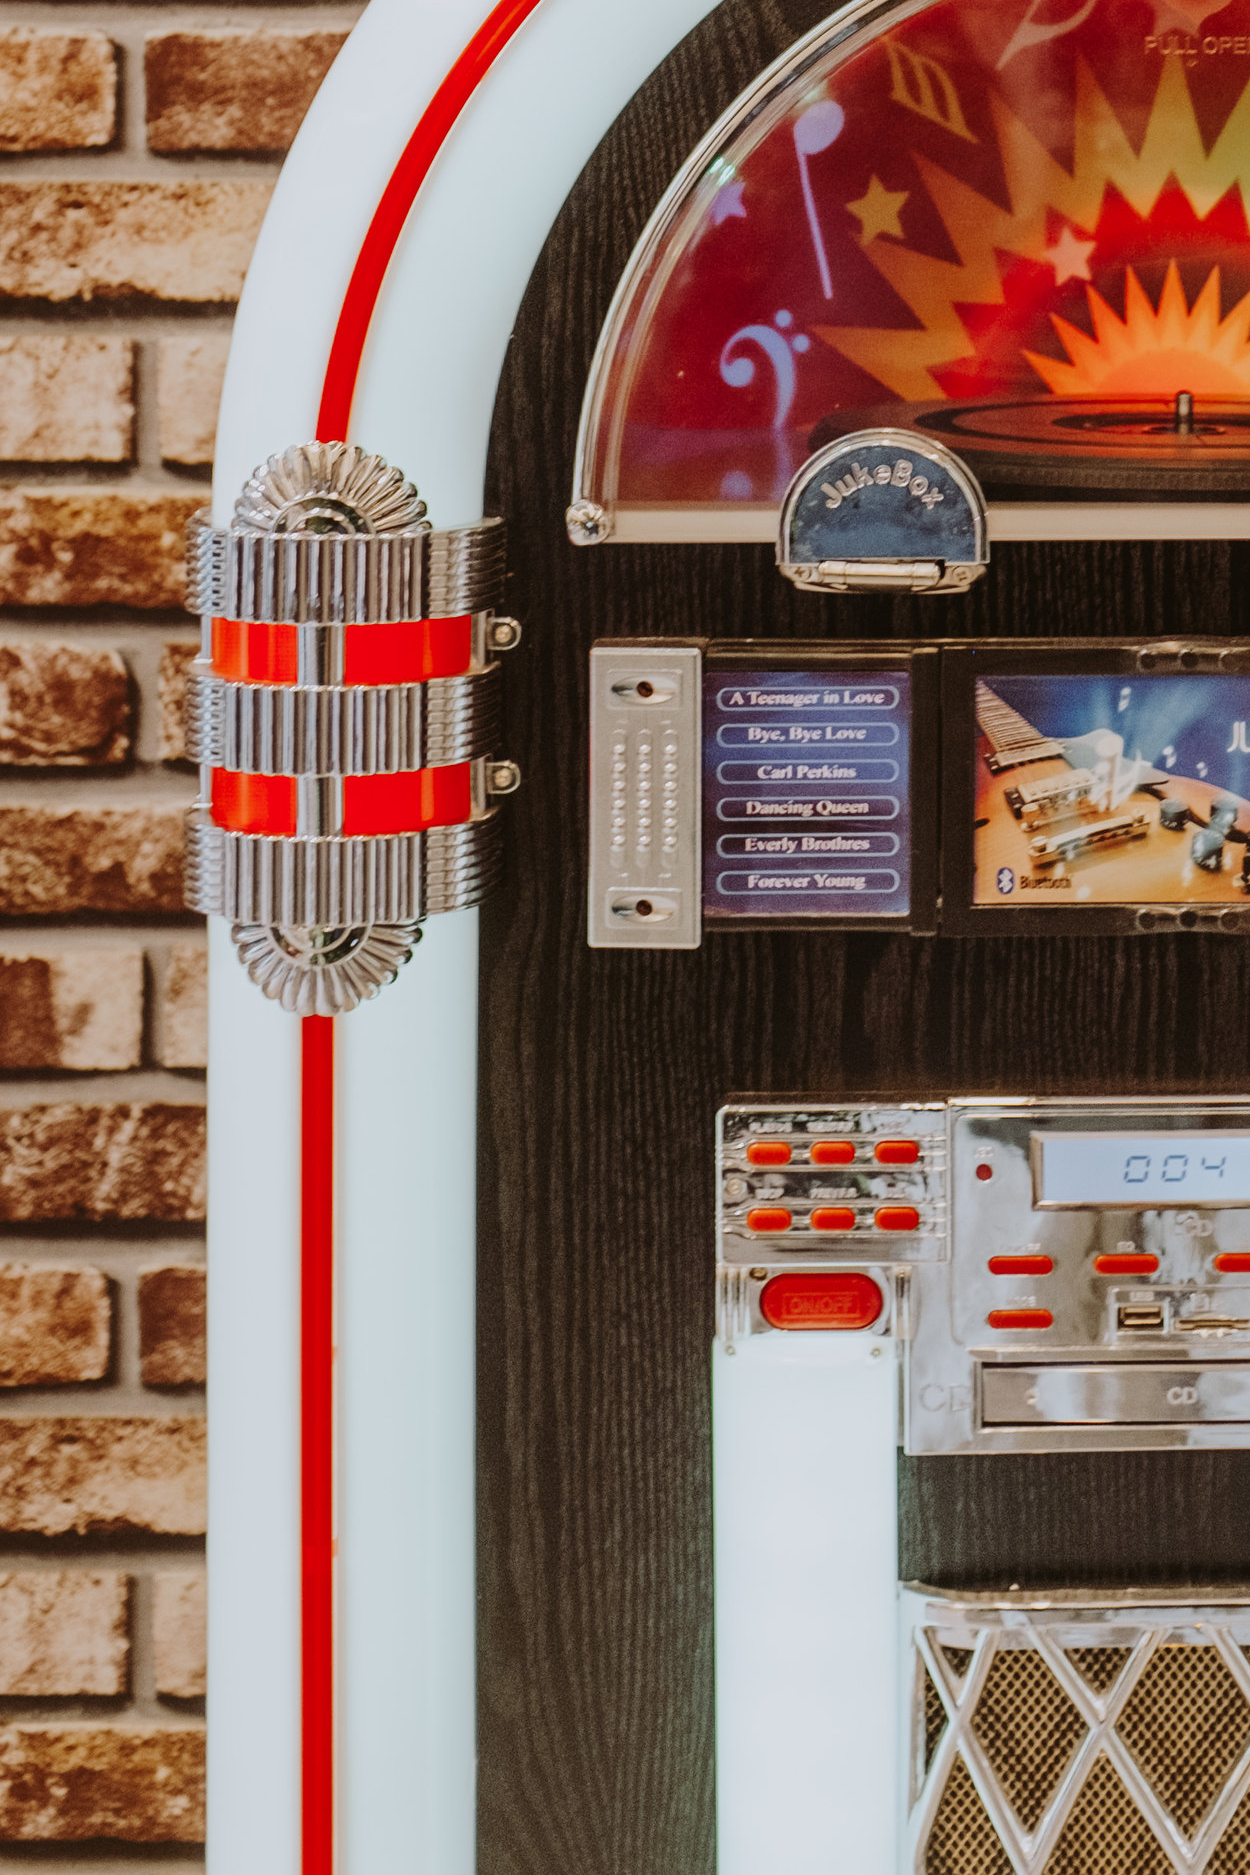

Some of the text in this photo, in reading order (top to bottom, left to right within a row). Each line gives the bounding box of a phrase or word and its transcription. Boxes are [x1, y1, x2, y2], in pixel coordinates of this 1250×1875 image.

[1143, 35, 1198, 55] PULL
[820, 458, 945, 510] JukeBox
[729, 690, 885, 707] A Teenager in Love
[748, 726, 867, 743] Bye, Bye Love
[757, 765, 857, 779] Carl Perkins
[746, 800, 869, 817] Dancing Queen
[744, 837, 871, 853] Everly Brothres
[748, 874, 867, 890] Forever Young
[1167, 1386, 1198, 1405] CD
